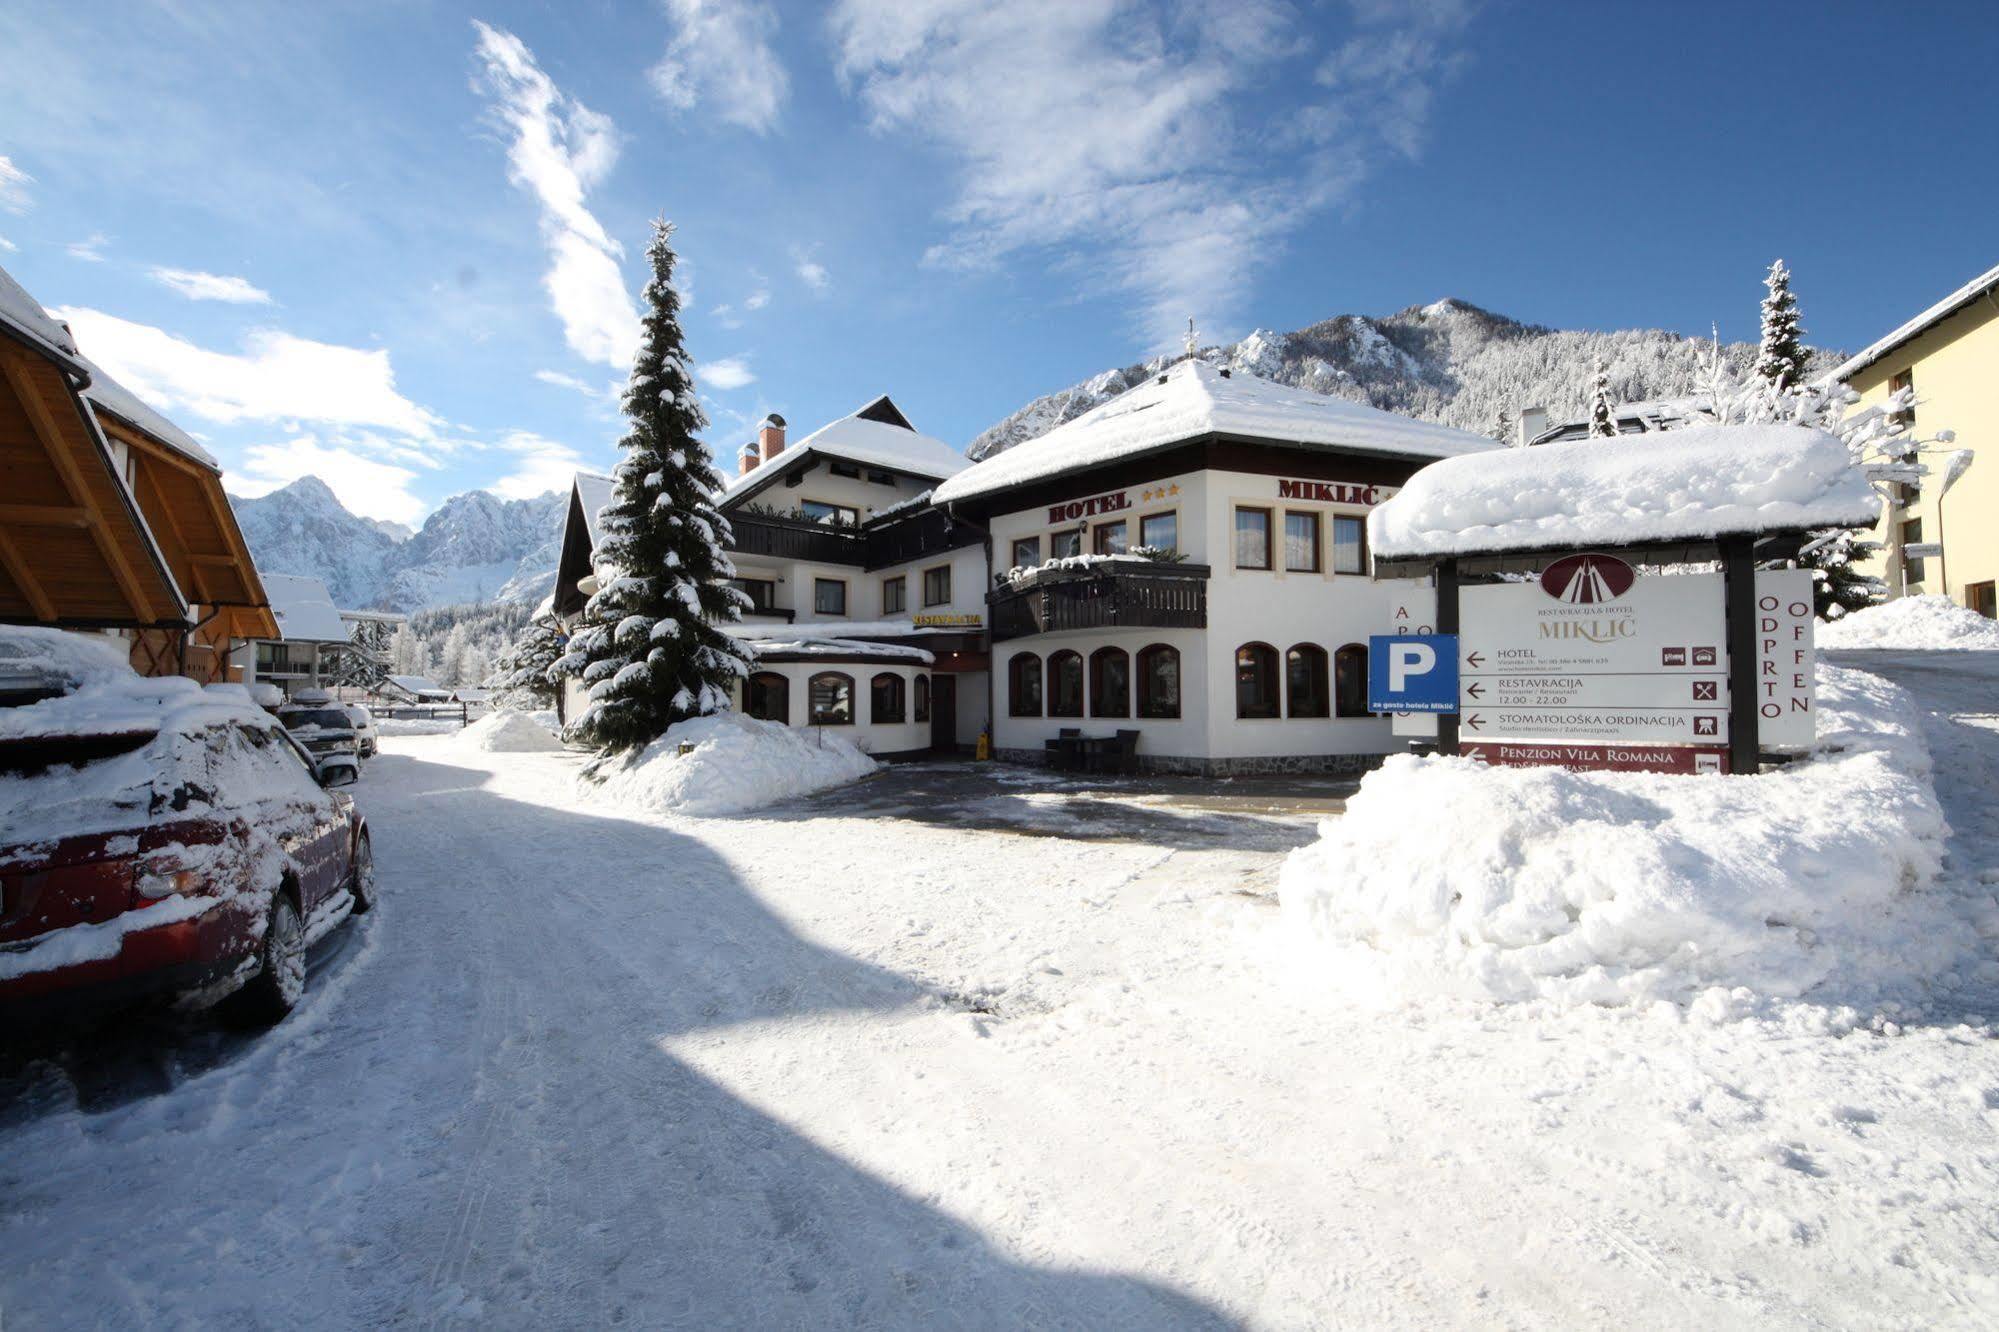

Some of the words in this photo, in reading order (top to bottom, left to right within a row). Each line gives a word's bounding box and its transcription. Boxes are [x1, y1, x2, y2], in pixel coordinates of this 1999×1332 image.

[1279, 479, 1379, 506] MIKLIČ
[1048, 491, 1132, 524] HOTEL
[1539, 615, 1636, 643] MIKLIČ
[1389, 643, 1436, 692] P
[1498, 650, 1536, 658] HOTEL
[1759, 596, 1781, 718] ODPRTO
[1788, 602, 1808, 712] OFFEN
[1499, 679, 1583, 689] RESTAVRACIJA
[1499, 697, 1527, 705] 12.00
[1537, 697, 1567, 705] 22.00
[1499, 714, 1602, 725] STOMATOLOŠKA
[1606, 716, 1685, 727] ORDINACIJA
